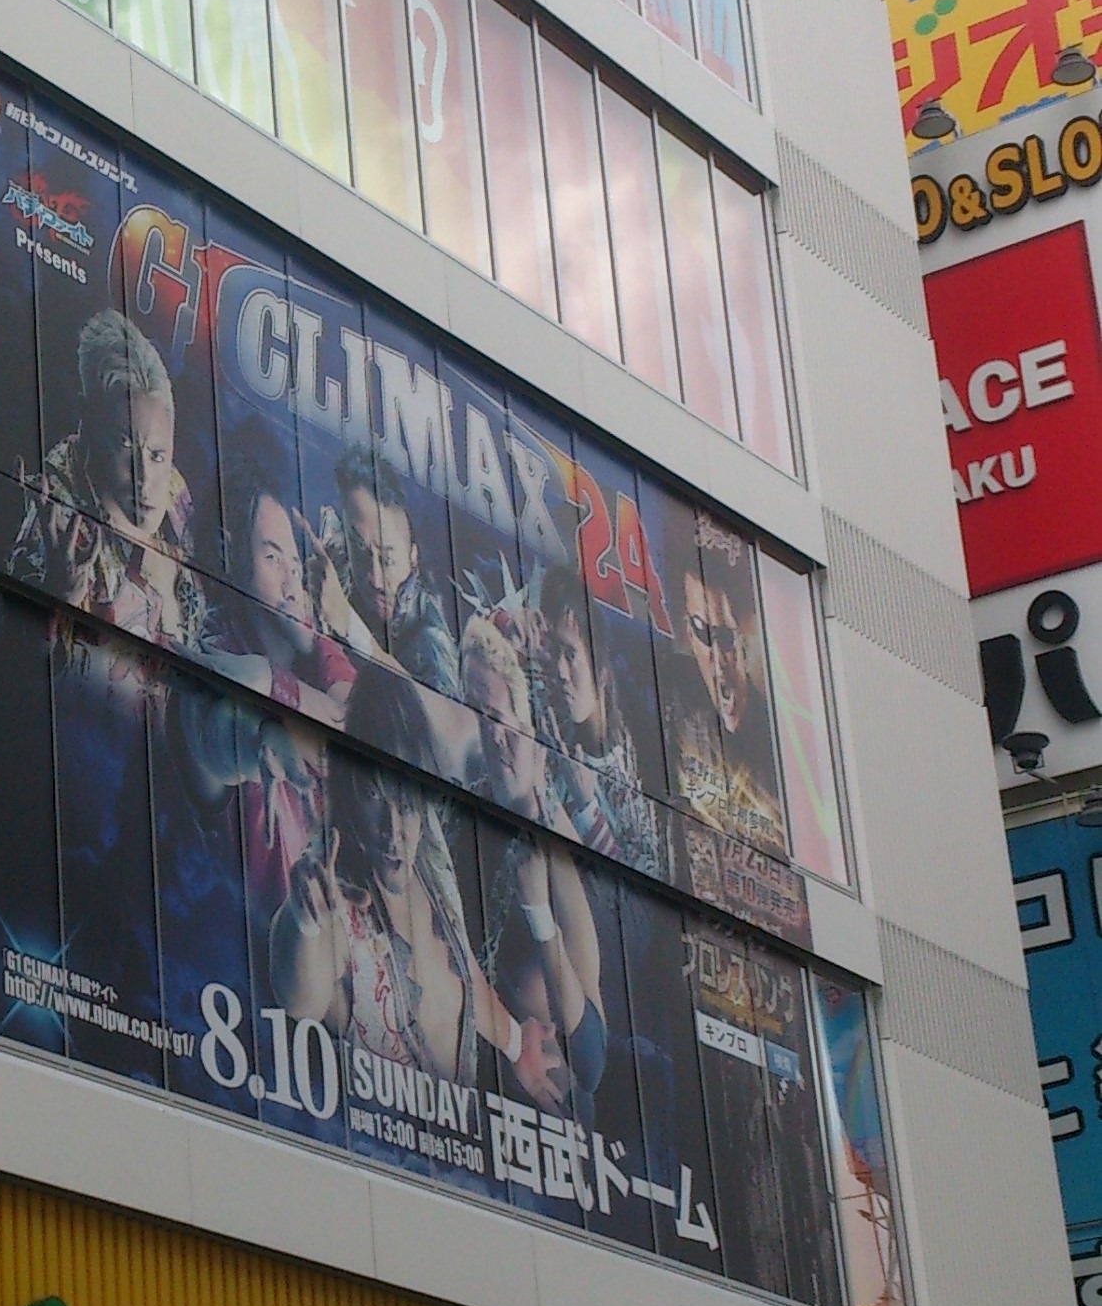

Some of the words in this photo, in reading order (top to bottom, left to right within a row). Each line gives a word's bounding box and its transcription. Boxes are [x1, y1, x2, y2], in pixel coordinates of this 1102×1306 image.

[16, 227, 87, 284] Presents
[237, 287, 569, 561] CLIMAX
[574, 463, 674, 638] 24
[200, 981, 340, 1121] 8.10
[485, 1091, 720, 1251] 西武ドーム
